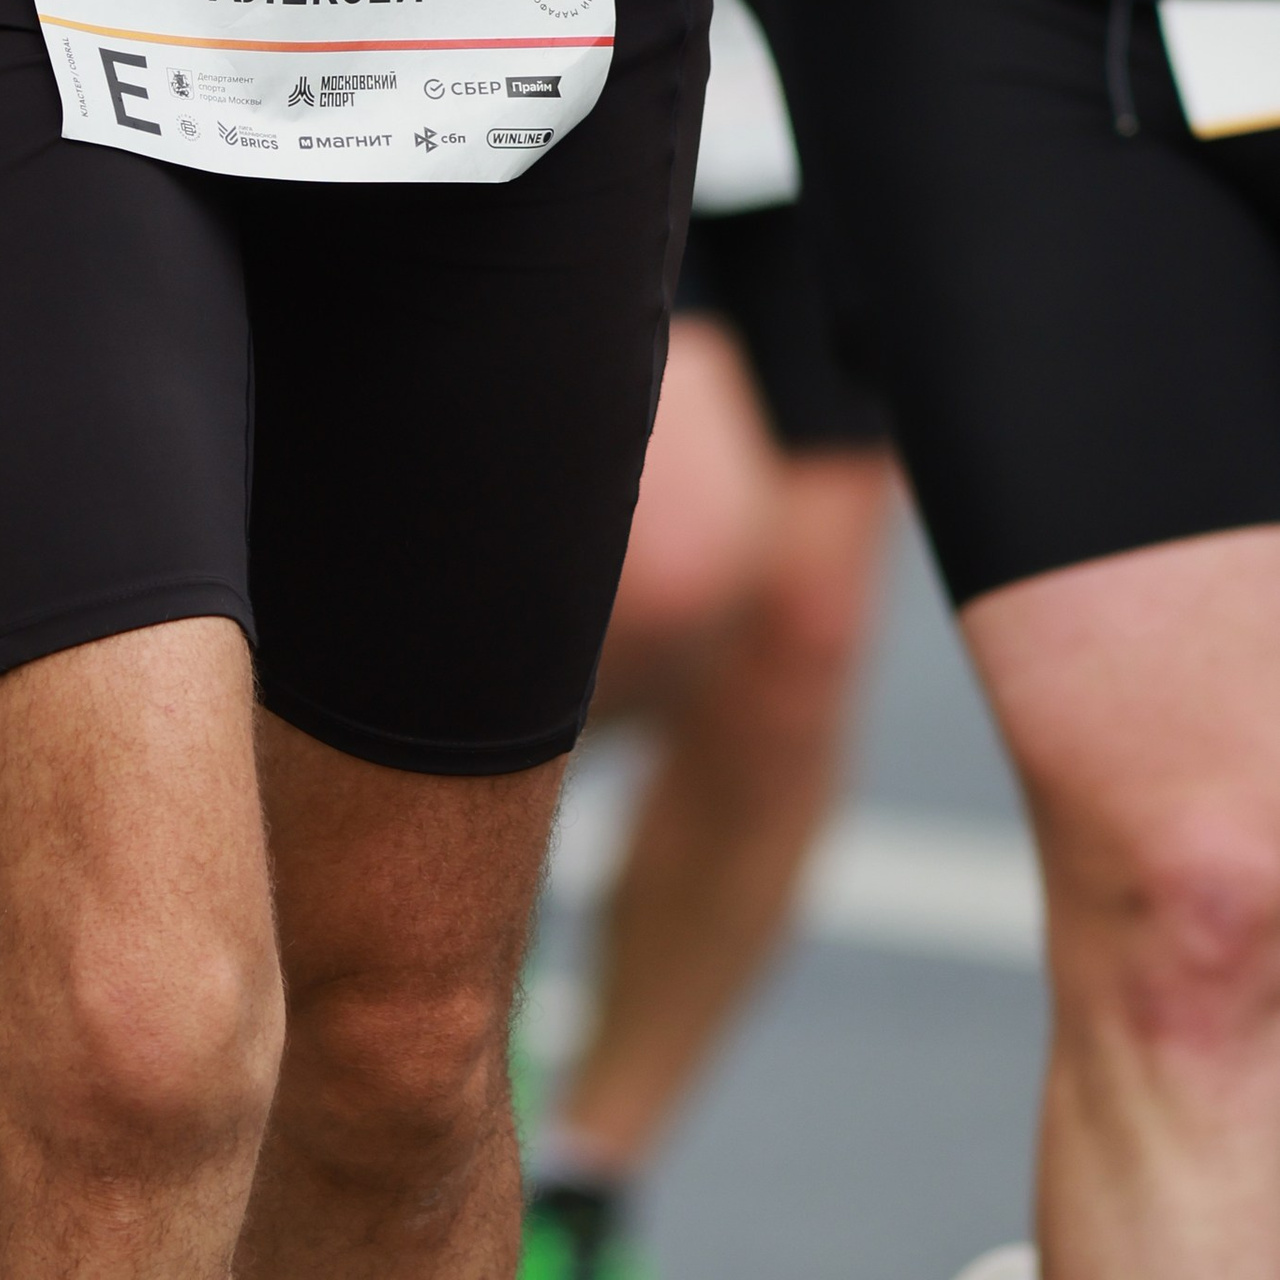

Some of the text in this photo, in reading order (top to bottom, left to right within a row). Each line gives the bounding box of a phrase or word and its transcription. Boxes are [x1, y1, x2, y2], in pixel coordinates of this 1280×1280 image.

[197, 72, 254, 85] Департамент
[320, 70, 398, 91] МОСКОВСКИЙ
[198, 83, 226, 94] спорта
[451, 78, 552, 96] СБЕР Прайм
[228, 96, 262, 106] Москвы
[319, 92, 355, 108] СПОРТ
[240, 137, 279, 150] BRICS
[492, 132, 543, 144] WINLINE
